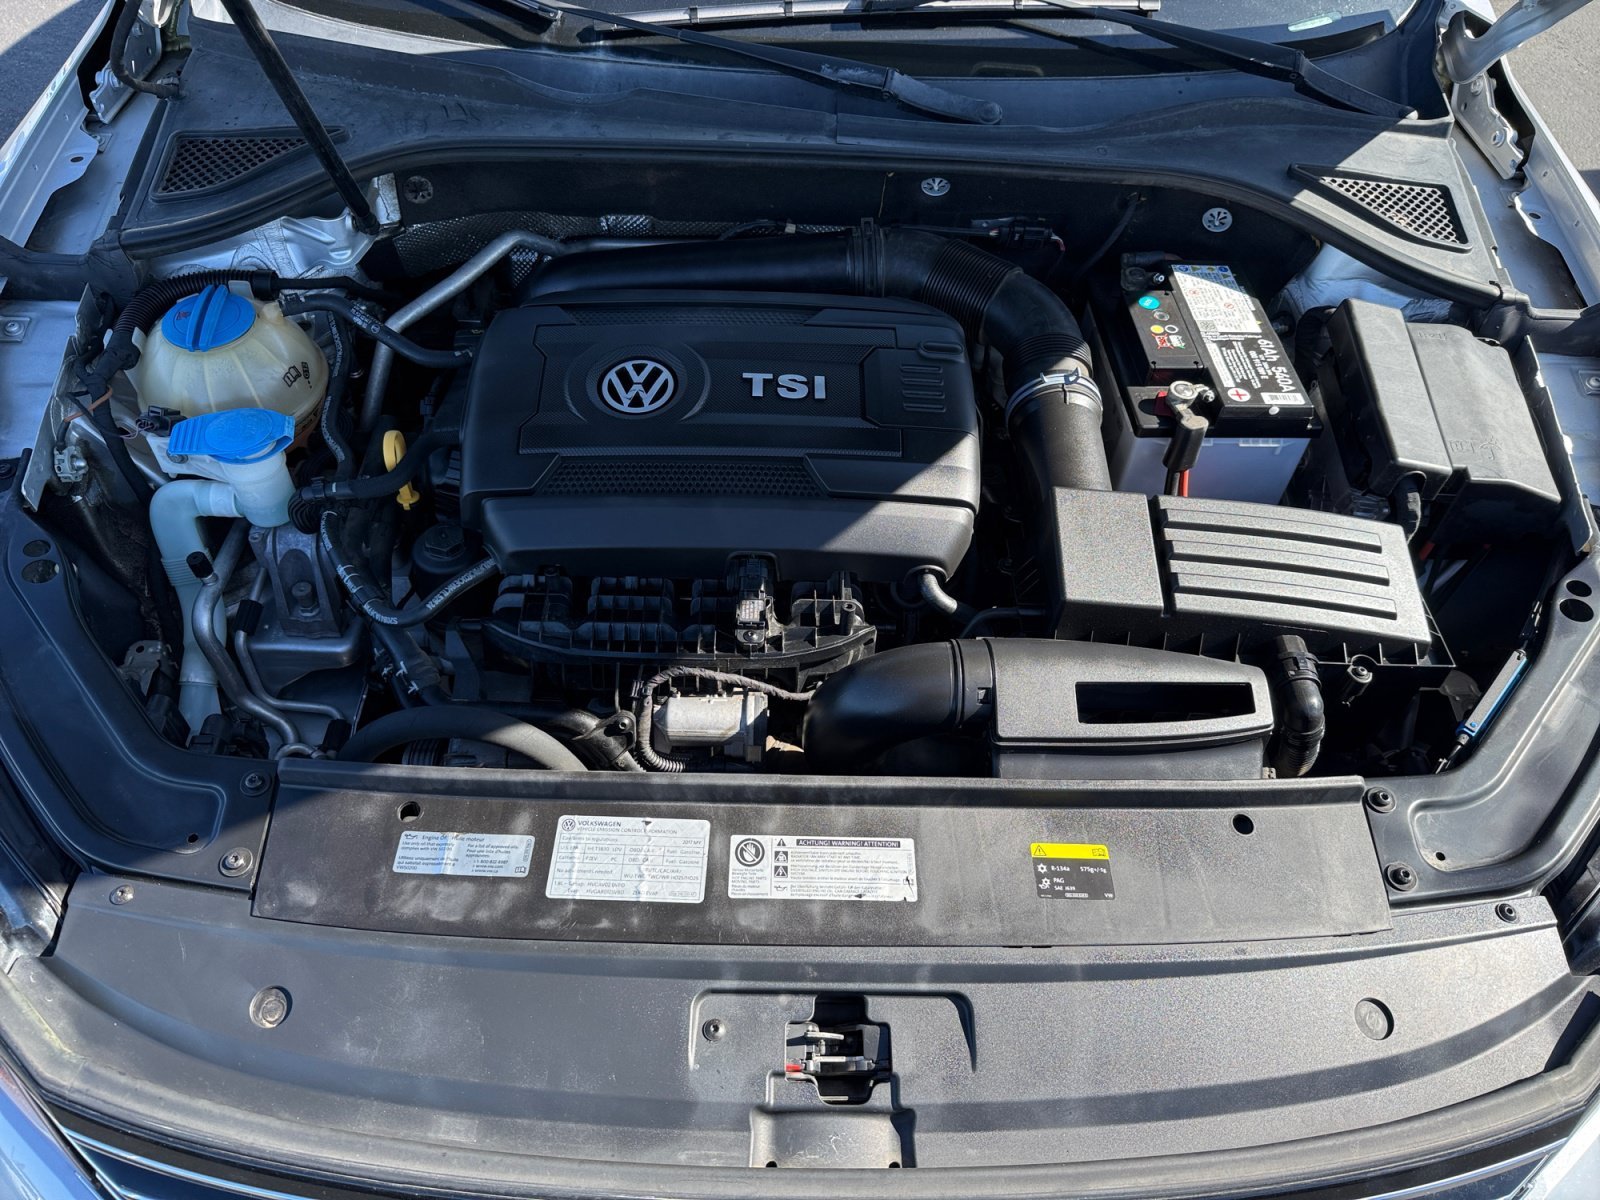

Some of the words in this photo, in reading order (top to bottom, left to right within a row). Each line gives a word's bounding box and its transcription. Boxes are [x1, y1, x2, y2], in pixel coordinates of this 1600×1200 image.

[1257, 339, 1280, 361] 61Ah
[1271, 366, 1296, 392] 540A
[742, 372, 826, 400] TSI
